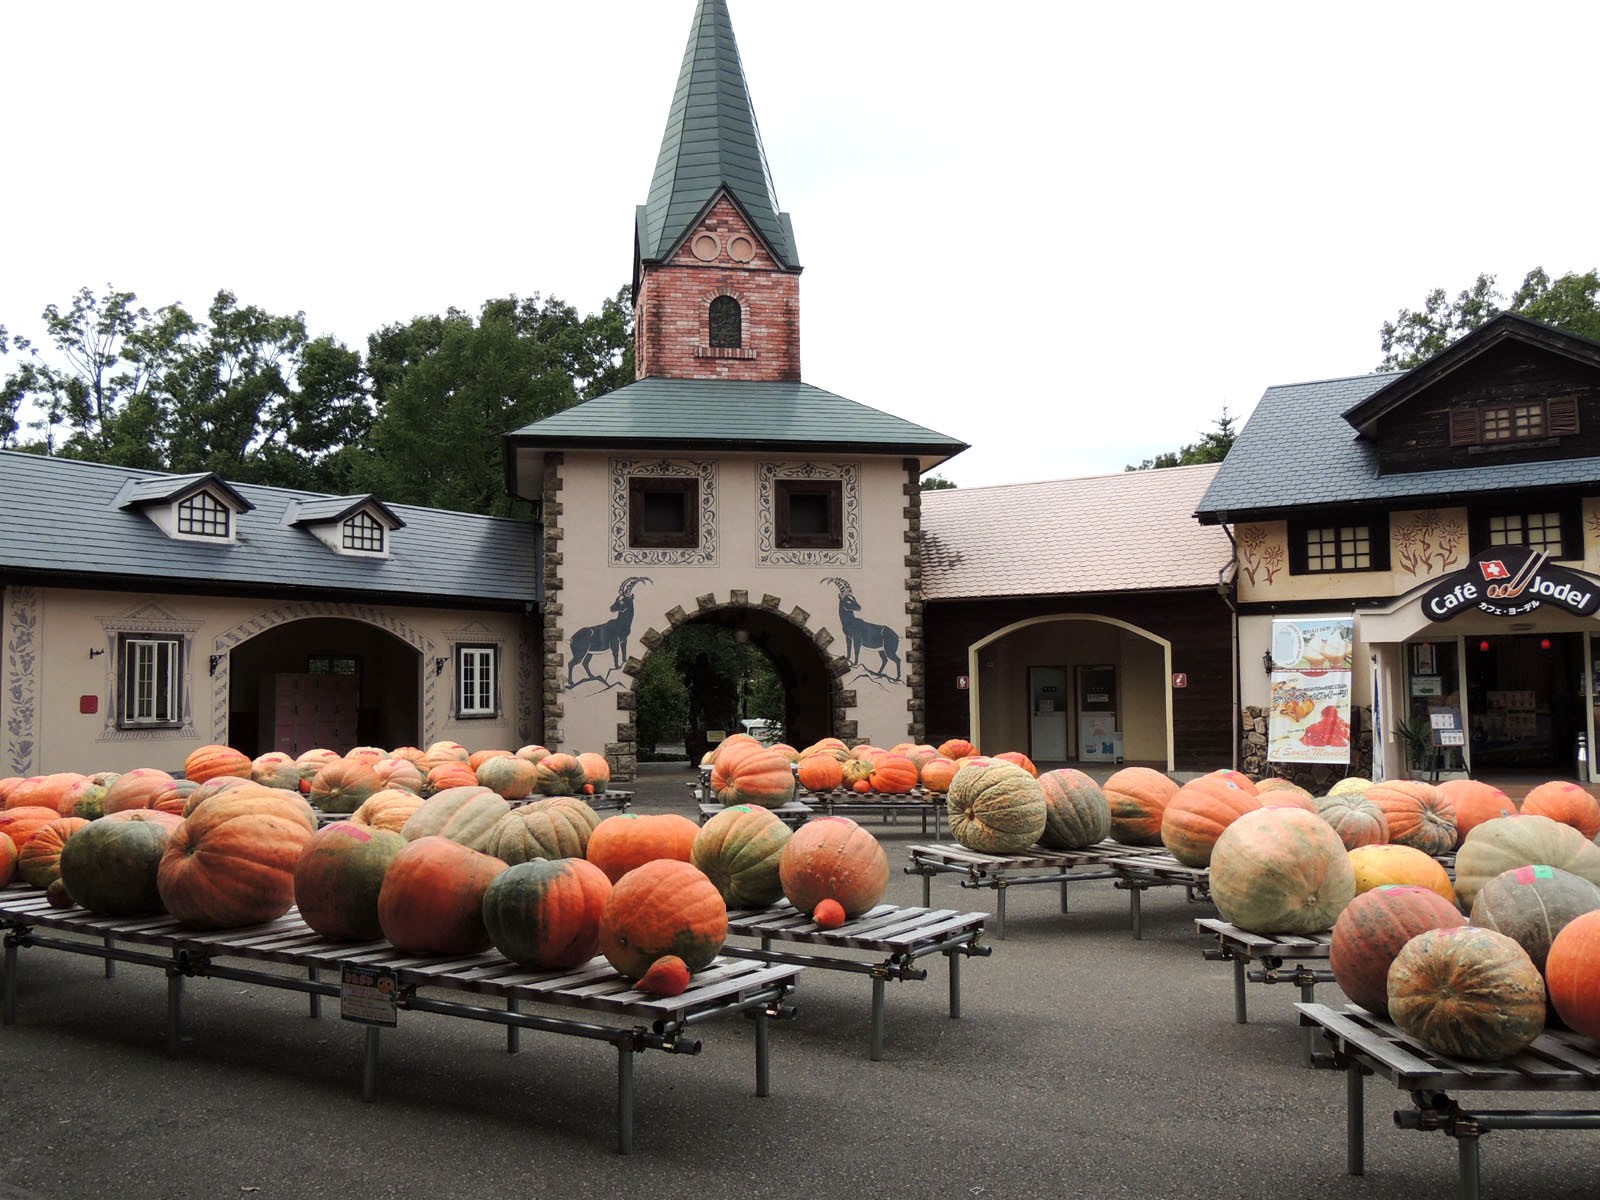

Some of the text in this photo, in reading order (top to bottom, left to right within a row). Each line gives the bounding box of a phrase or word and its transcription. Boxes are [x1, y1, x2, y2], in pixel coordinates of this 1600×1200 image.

[1430, 576, 1591, 614] Café Jodel
[1478, 600, 1540, 615] カフェ・ヨーデル
